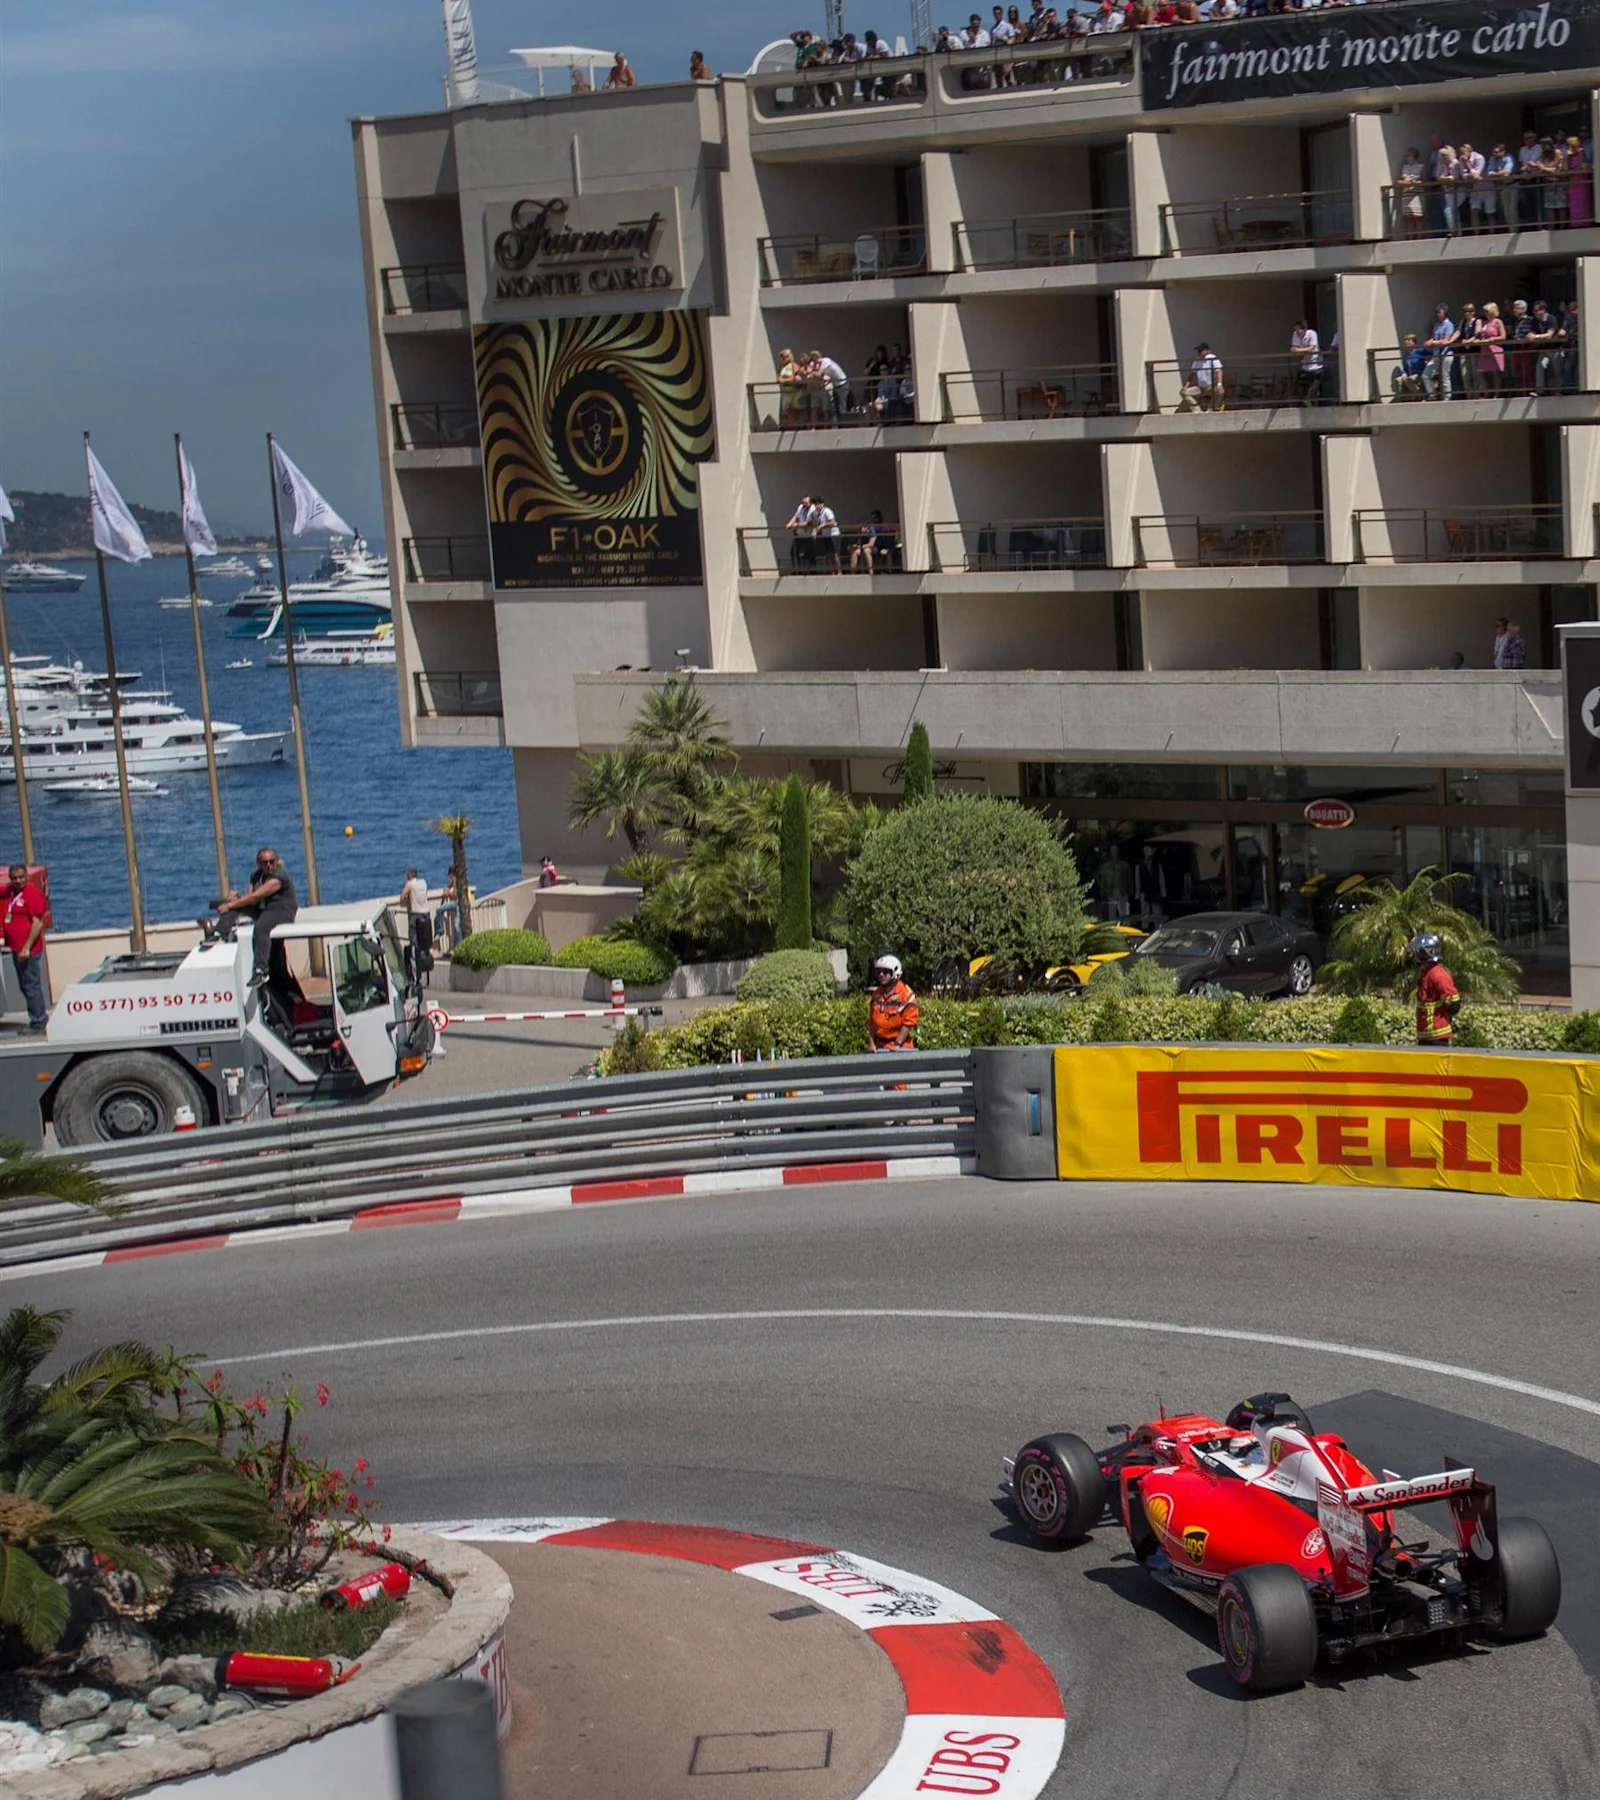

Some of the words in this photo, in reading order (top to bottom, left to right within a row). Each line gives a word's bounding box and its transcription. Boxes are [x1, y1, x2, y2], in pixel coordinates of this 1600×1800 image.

[1166, 37, 1332, 100] fairmont
[1342, 27, 1461, 69] monte
[1472, 3, 1571, 55] carlo
[494, 198, 667, 271] Fairmont
[495, 271, 583, 299] MONTE
[588, 265, 674, 292] CARLO
[599, 552, 632, 562] FAIRMONT
[1309, 808, 1348, 821] BUGATTI
[67, 1001, 93, 1015] (00
[99, 998, 134, 1012] 377)
[138, 996, 158, 1009] 93
[163, 995, 183, 1007] 50
[188, 992, 208, 1004] 72
[213, 991, 233, 1002] 50
[161, 1017, 239, 1034] LIEBHERR
[1137, 1070, 1529, 1177] PIRELLI
[1373, 1475, 1470, 1503] Santander
[773, 1560, 895, 1599] UBS
[915, 1731, 1021, 1796] UBS
